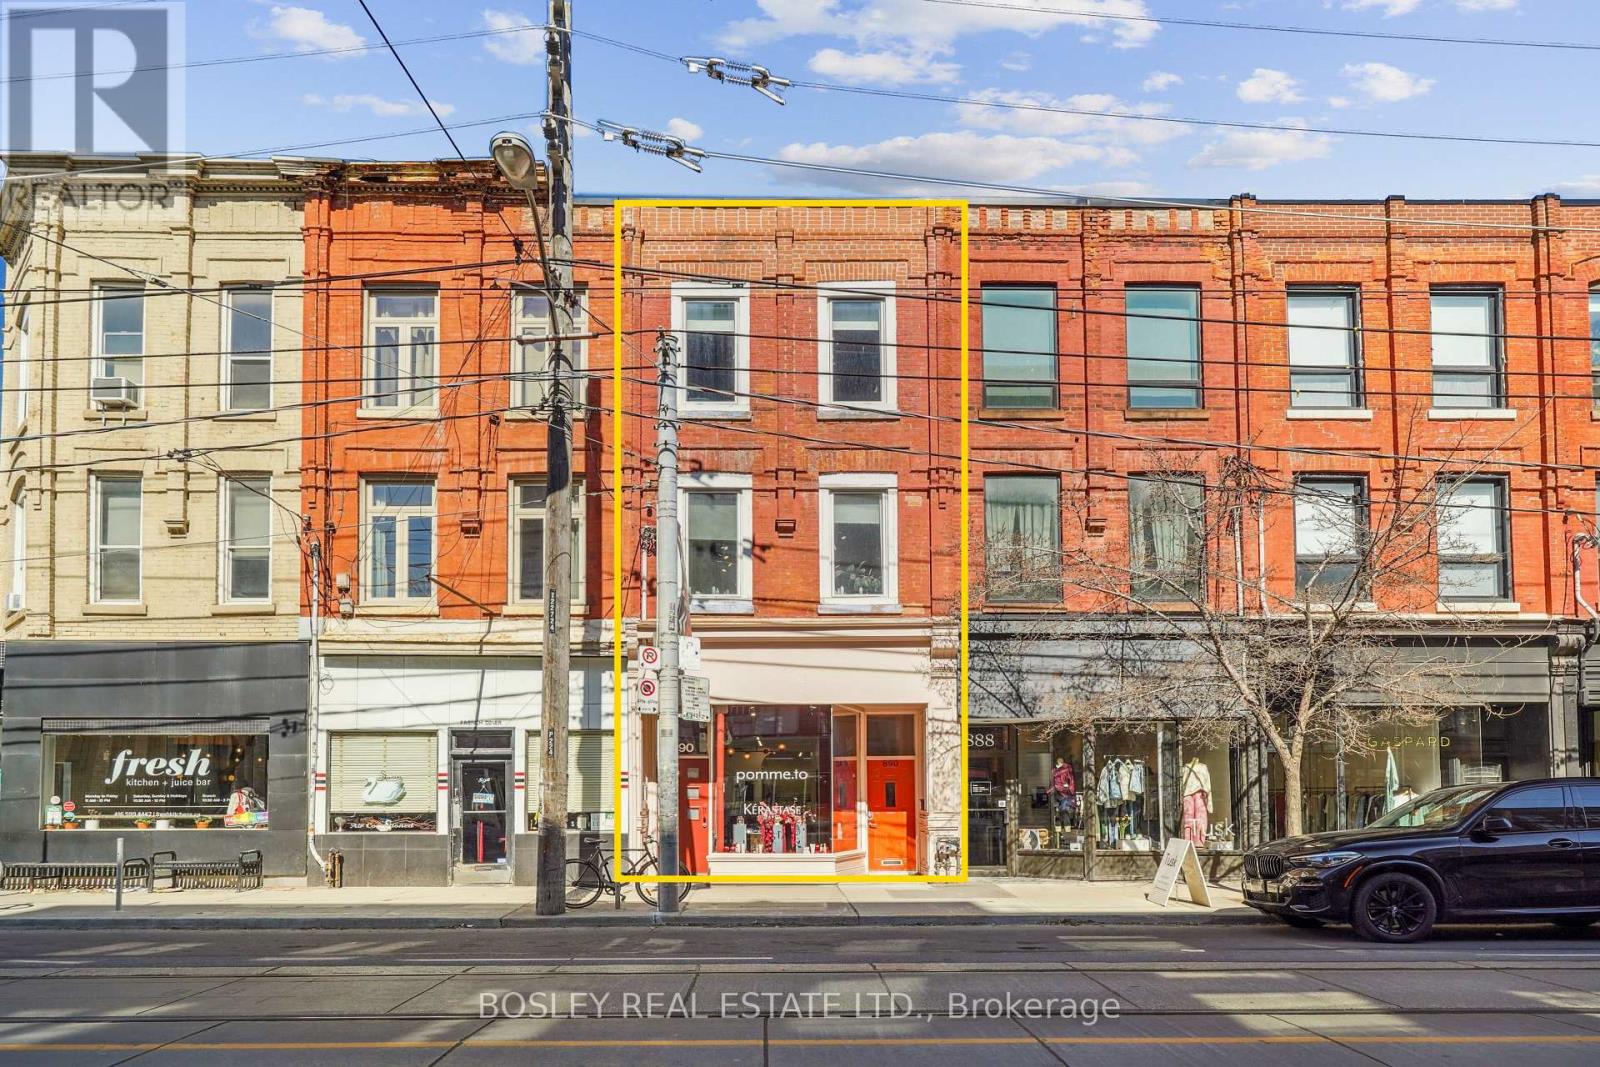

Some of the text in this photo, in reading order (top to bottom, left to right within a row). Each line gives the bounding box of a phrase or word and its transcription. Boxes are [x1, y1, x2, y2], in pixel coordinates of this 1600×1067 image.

[679, 742, 694, 753] 90
[1367, 736, 1451, 748] GASPARD
[104, 749, 211, 785] fresh
[126, 778, 159, 787] kitchen
[171, 777, 193, 788] juice
[196, 777, 211, 786] bar
[736, 769, 809, 783] pomme.to
[1184, 817, 1236, 836] Tusk
[1165, 852, 1178, 868] Tusk
